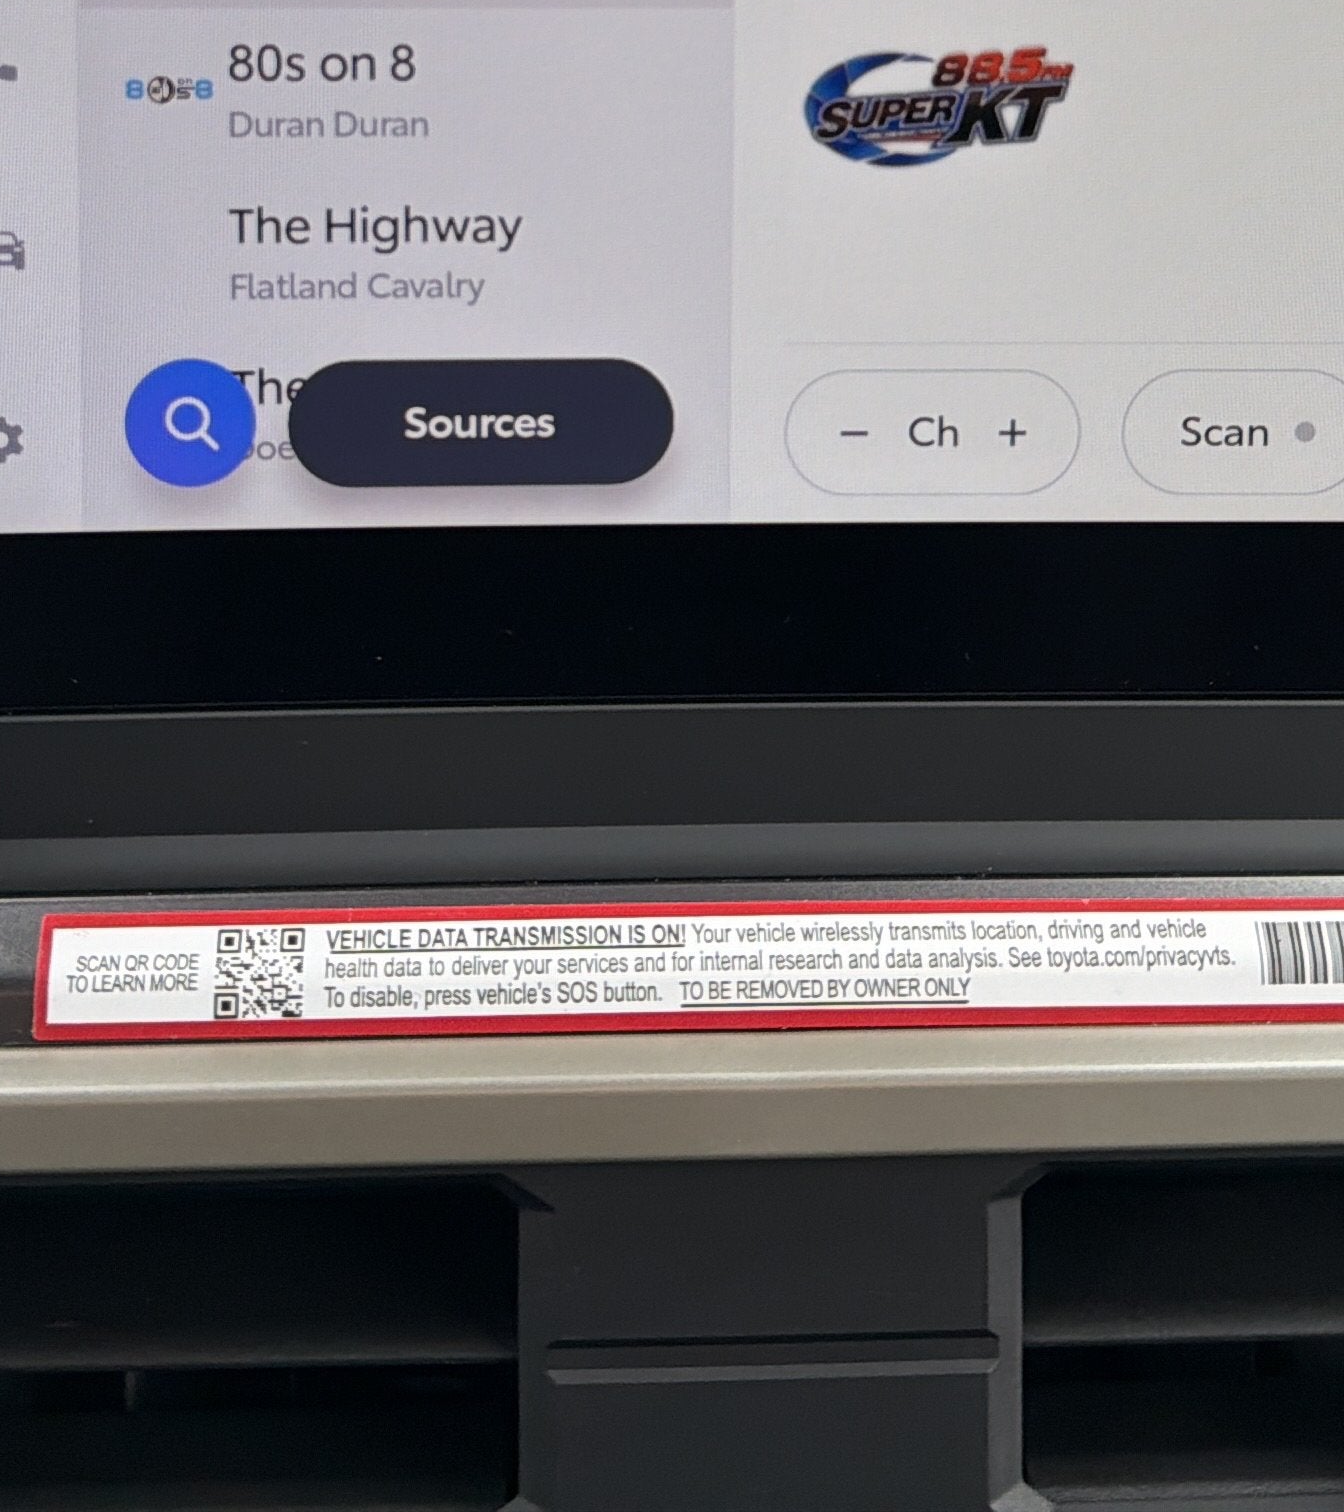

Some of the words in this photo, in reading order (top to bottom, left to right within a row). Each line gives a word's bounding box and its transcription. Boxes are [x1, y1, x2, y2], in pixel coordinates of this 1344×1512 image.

[228, 43, 306, 82] 80s
[320, 53, 376, 82] on
[391, 43, 416, 82] 8
[229, 111, 324, 138] Duran
[334, 111, 429, 138] Duran
[230, 207, 311, 245] The
[325, 205, 522, 254] Highway
[230, 272, 356, 300] Flatland
[367, 272, 485, 306] Cavalry
[404, 405, 556, 440] Sources
[908, 415, 960, 448] Ch
[1180, 416, 1269, 448] Scan
[327, 929, 411, 950] VEHICLE
[418, 928, 468, 948] DATA
[473, 925, 622, 946] TRANSMISSION
[628, 925, 645, 944] IS
[652, 923, 686, 944] ON!
[692, 923, 731, 943] Your
[736, 922, 795, 942] vehicle
[801, 921, 883, 946] wirelessly
[889, 920, 966, 940] transmits
[971, 920, 1043, 942] location,
[1048, 919, 1104, 944] driving
[1110, 919, 1141, 939] and
[1147, 918, 1206, 938] vehicle
[76, 955, 121, 972] SCAN
[125, 955, 149, 971] QR
[153, 954, 200, 971] CODE
[325, 957, 377, 978] health
[384, 956, 421, 978] data
[429, 957, 445, 975] to
[452, 955, 507, 975] deliver
[513, 958, 552, 980] your
[557, 953, 628, 974] services
[634, 952, 665, 972] and
[672, 951, 694, 972] for
[700, 950, 762, 971] internal
[769, 949, 842, 970] research
[849, 949, 879, 969] and
[886, 948, 922, 968] data
[928, 947, 1003, 973] analysis.
[1008, 946, 1042, 967] See
[1047, 945, 1236, 972] toyota.com/privacyvts.
[66, 975, 88, 993] TO
[92, 974, 146, 992] LEARN
[150, 973, 199, 991] MORE
[324, 986, 344, 1008] To
[350, 985, 418, 1009] disable,
[424, 987, 471, 1010] press
[477, 982, 551, 1005] vehicle's
[557, 981, 597, 1003] SOS
[604, 981, 663, 1002] button.
[679, 981, 703, 1000] TO
[709, 980, 731, 999] BE
[737, 979, 823, 999] REMOVED
[827, 979, 851, 998] BY
[855, 978, 921, 997] OWNER
[925, 977, 971, 996] ONLY
